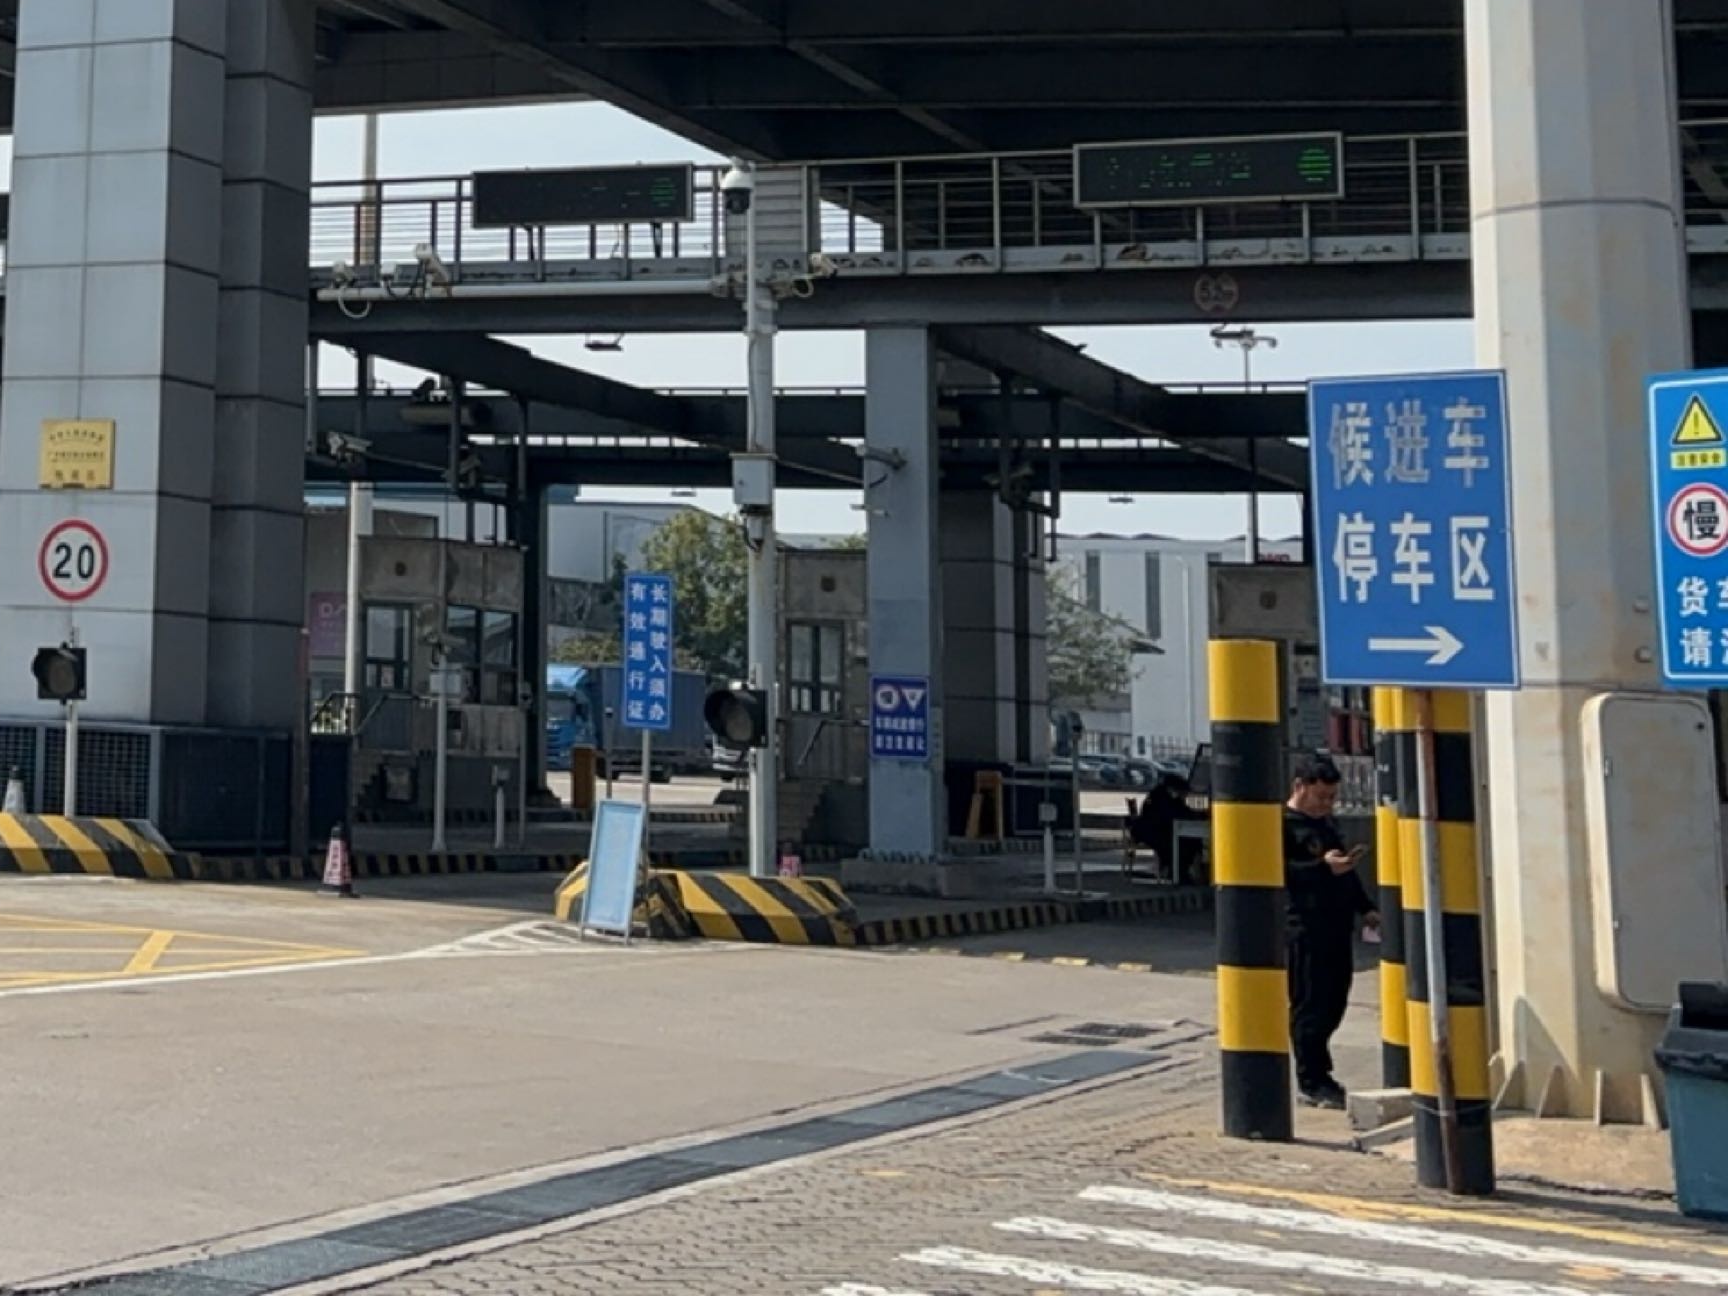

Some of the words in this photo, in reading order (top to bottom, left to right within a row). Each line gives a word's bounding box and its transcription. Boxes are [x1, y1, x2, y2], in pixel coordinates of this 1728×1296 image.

[1327, 396, 1490, 490] 候进车
[1682, 500, 1720, 541] 慢
[52, 541, 95, 580] 20
[1332, 512, 1494, 604] 停车区
[1679, 626, 1728, 668] 请
